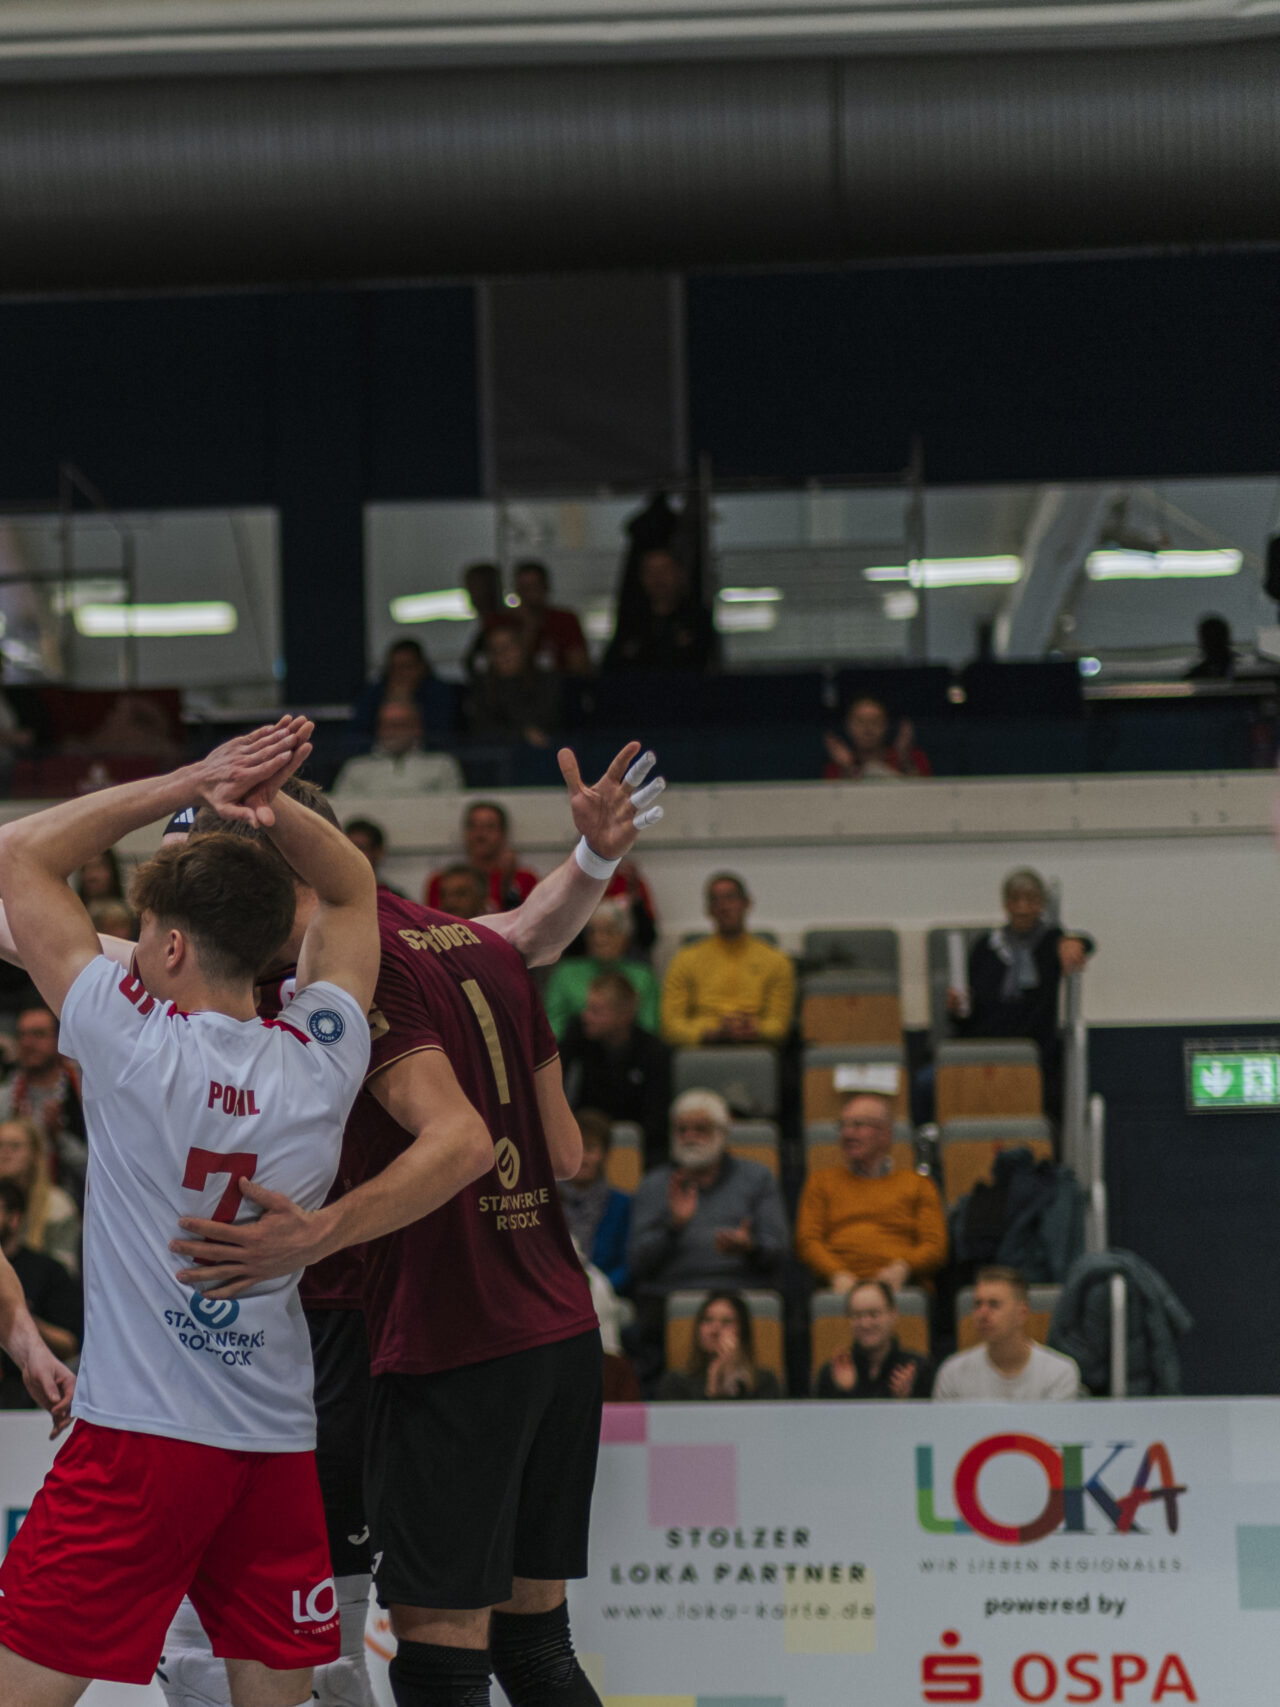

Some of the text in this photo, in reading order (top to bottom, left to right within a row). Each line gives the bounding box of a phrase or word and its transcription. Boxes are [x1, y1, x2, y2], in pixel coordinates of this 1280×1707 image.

[915, 1431, 1188, 1547] LOKA
[666, 1527, 810, 1549] STOLZER
[610, 1562, 867, 1585] LOKA PARTNER
[984, 1593, 1127, 1618] powered by
[1012, 1652, 1198, 1704] OSPA
